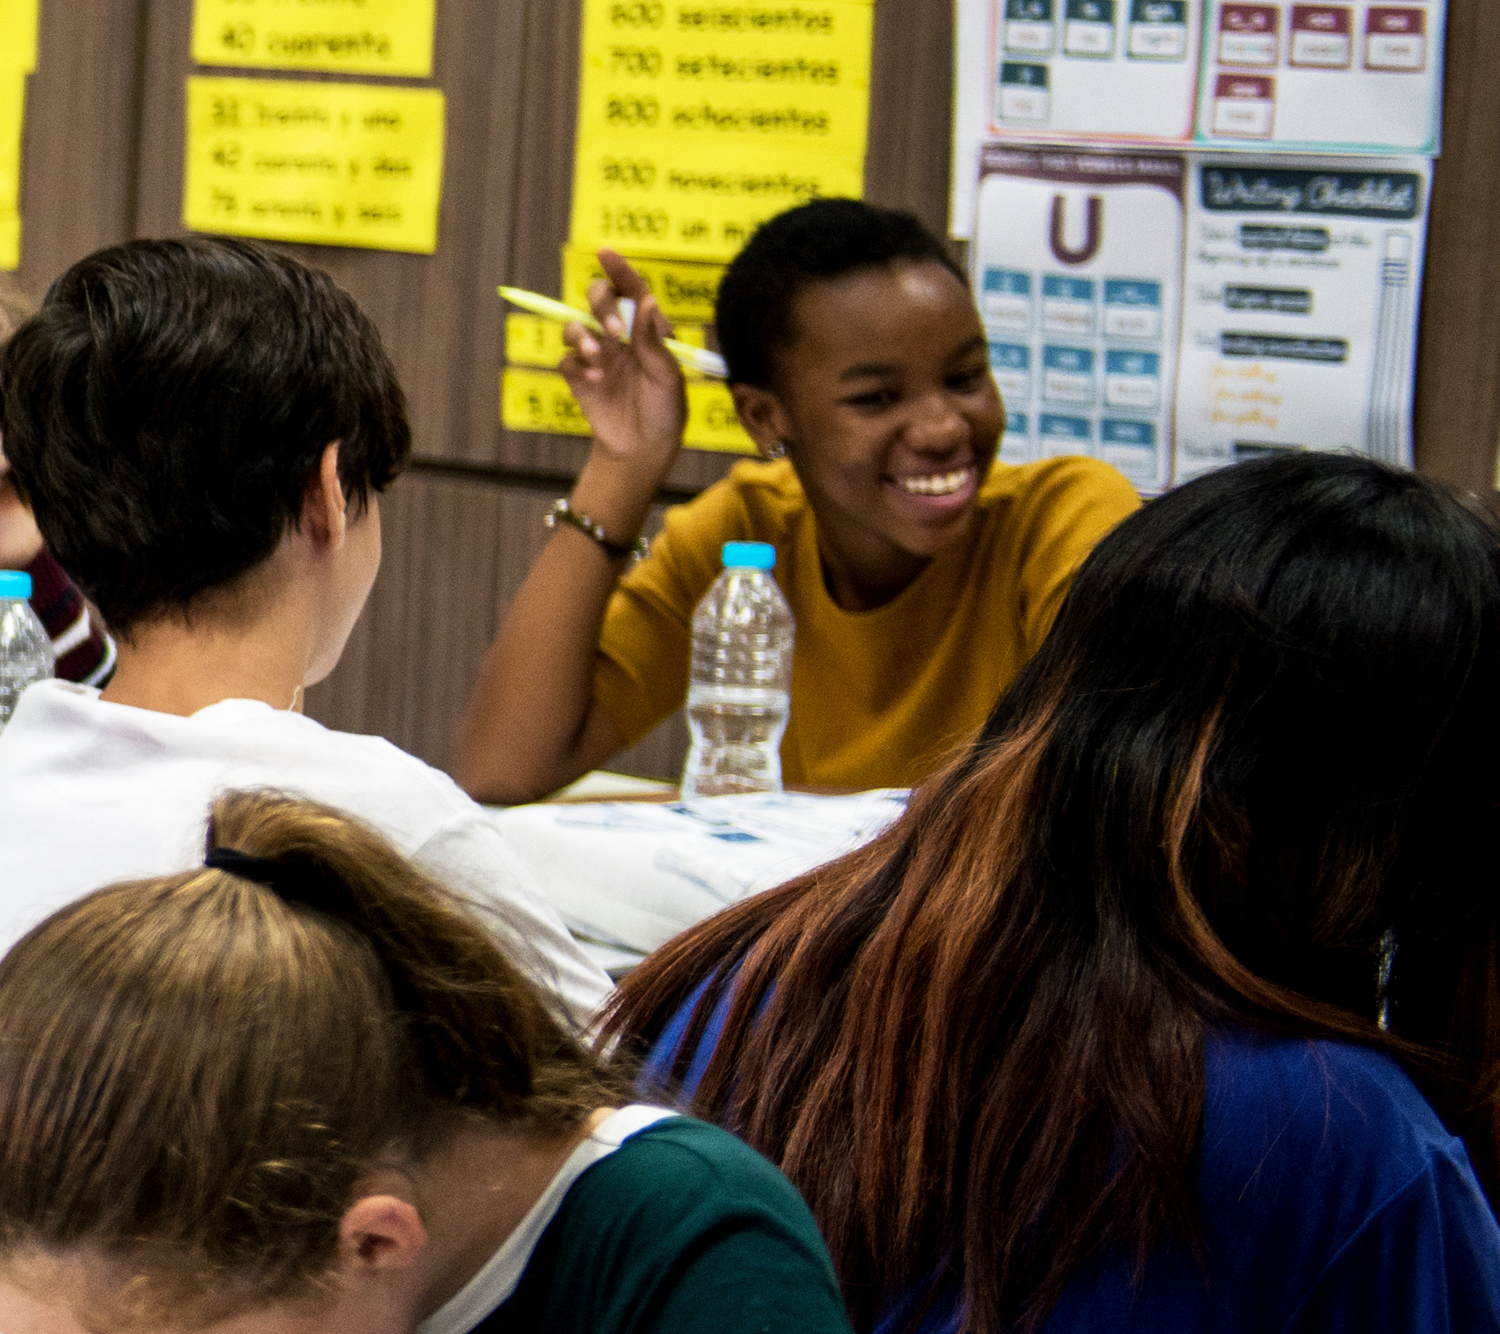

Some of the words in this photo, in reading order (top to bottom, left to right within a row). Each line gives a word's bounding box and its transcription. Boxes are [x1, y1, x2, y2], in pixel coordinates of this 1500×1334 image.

[1206, 170, 1302, 214] Writing
[1307, 175, 1412, 211] Checklist
[1048, 194, 1104, 266] U
